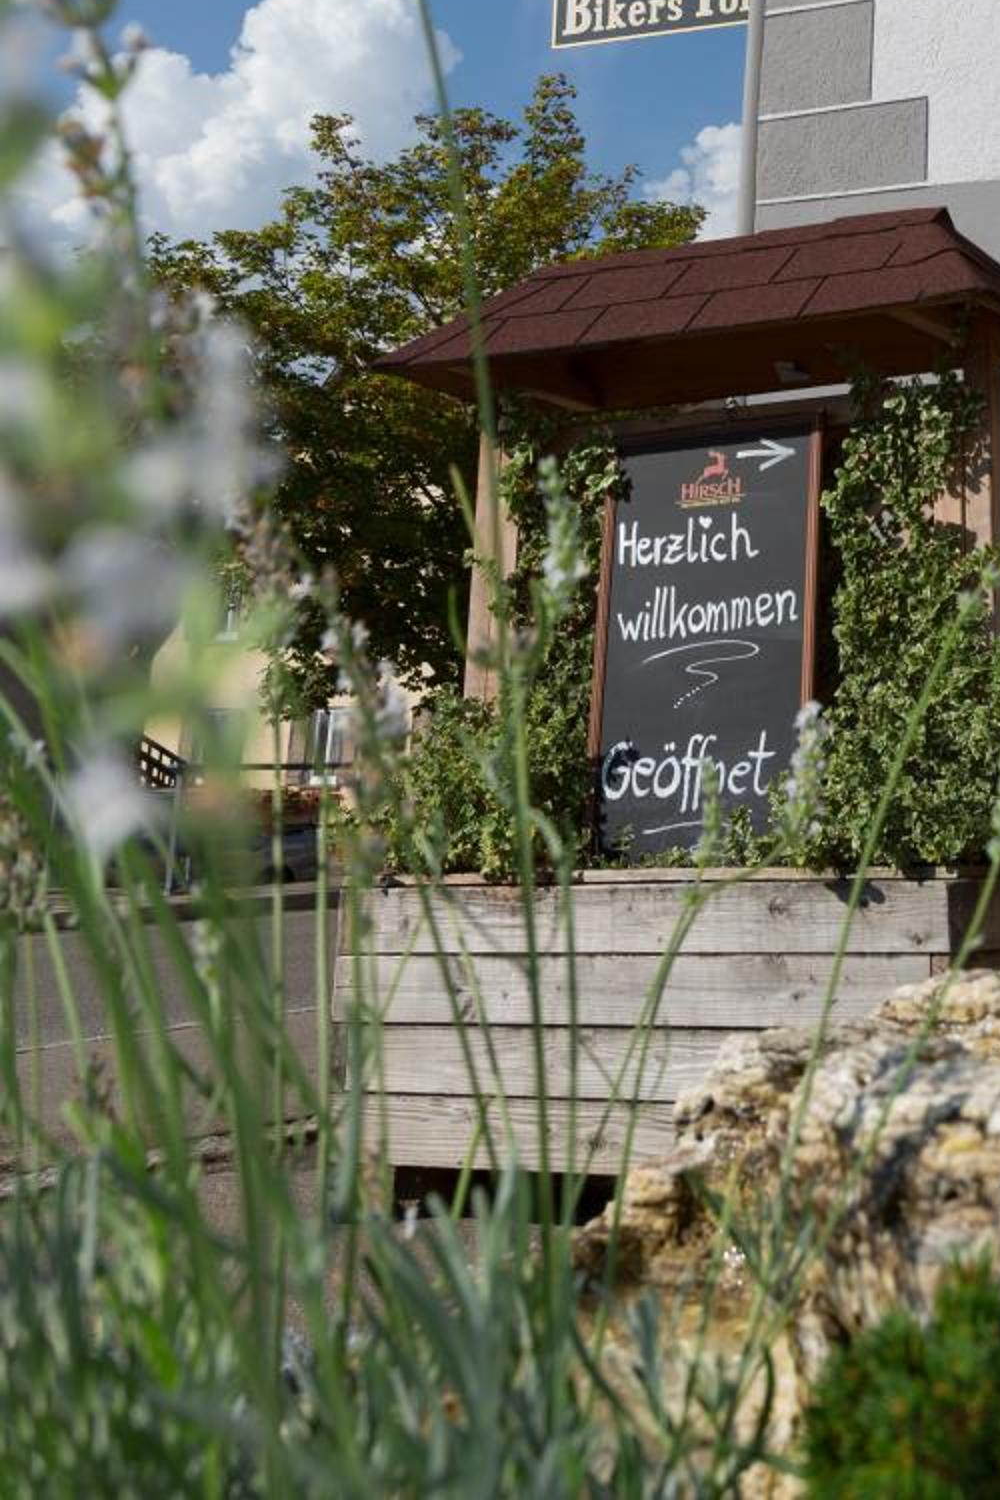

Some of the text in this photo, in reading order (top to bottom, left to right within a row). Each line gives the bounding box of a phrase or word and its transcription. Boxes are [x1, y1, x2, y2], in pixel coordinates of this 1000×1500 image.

[680, 476, 742, 501] HIRSCH
[618, 511, 759, 568] Herzlich
[617, 585, 799, 642] willkommen
